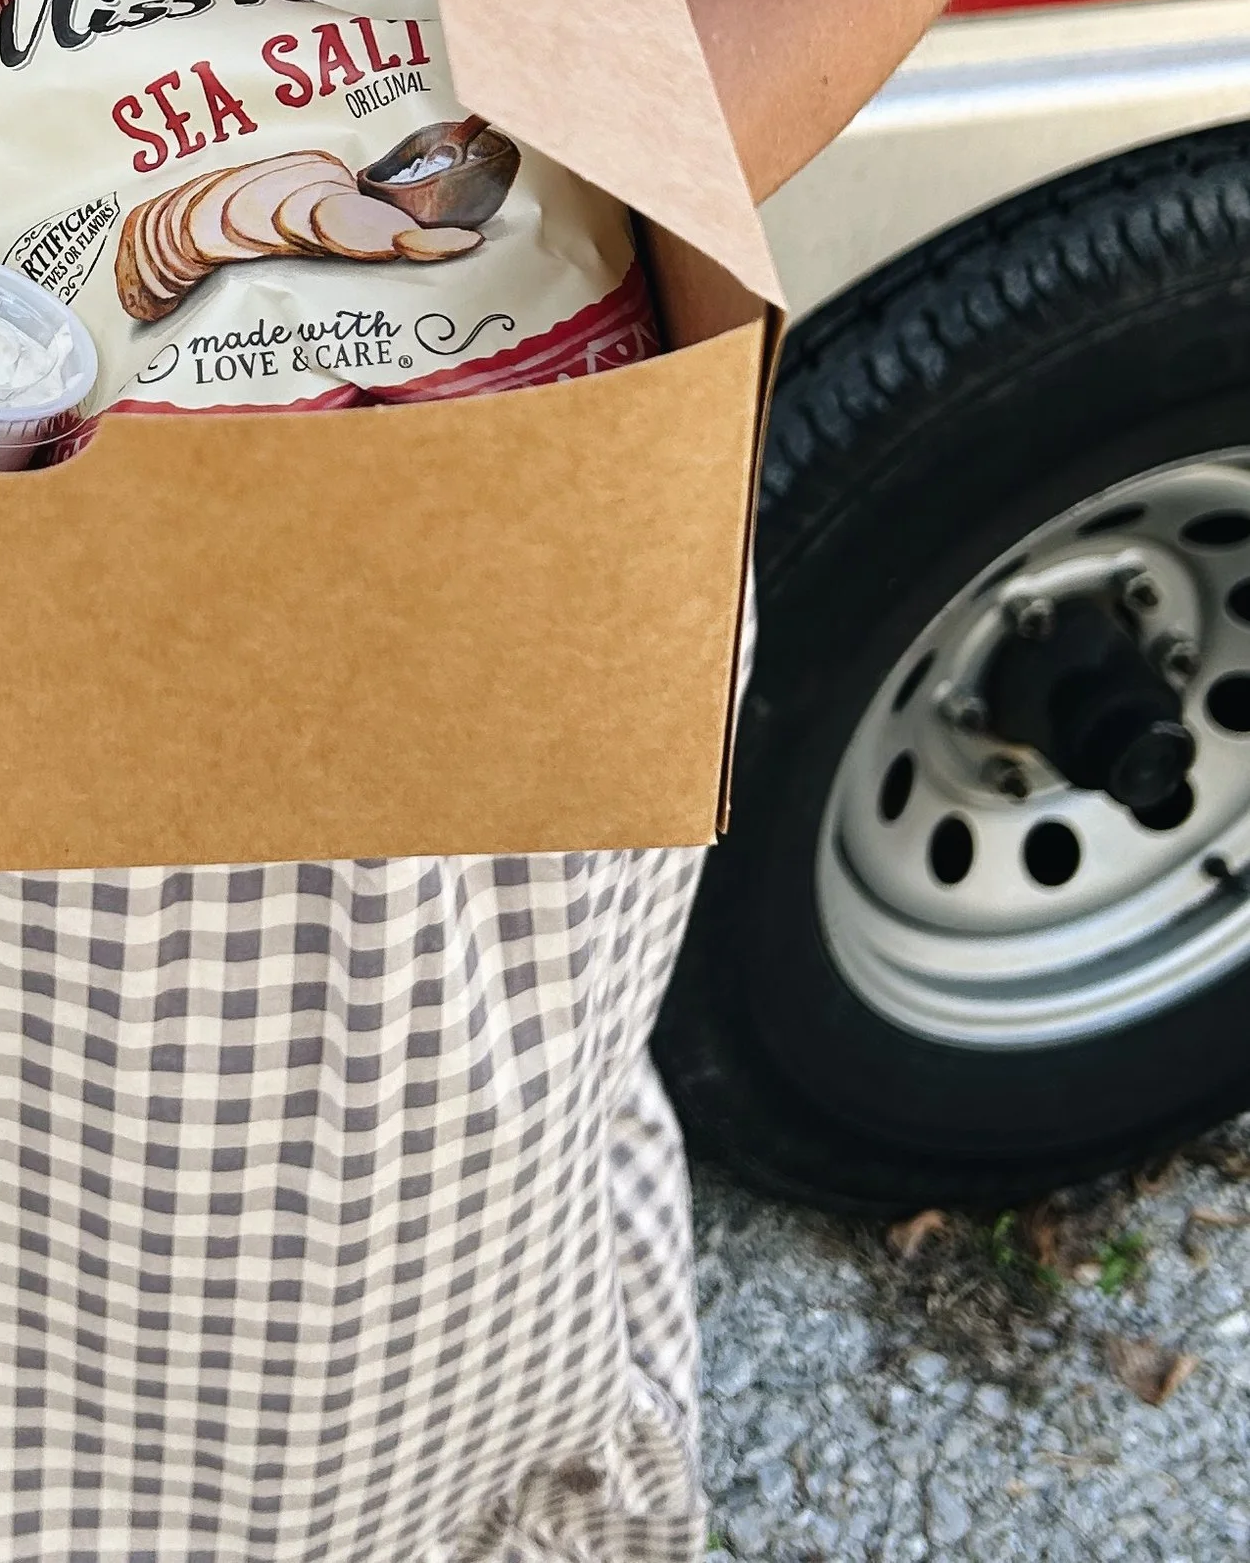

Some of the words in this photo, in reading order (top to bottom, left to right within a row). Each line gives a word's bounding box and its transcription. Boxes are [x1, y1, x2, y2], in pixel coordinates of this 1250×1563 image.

[111, 60, 258, 173] SEA
[345, 70, 432, 119] ORIGINAL
[20, 197, 109, 283] RTIFICIAL
[64, 245, 83, 265] OR
[75, 203, 115, 251] FLAVORS
[187, 318, 293, 355] made
[297, 310, 402, 341] with
[195, 350, 279, 385] LOVE
[292, 346, 311, 372] &
